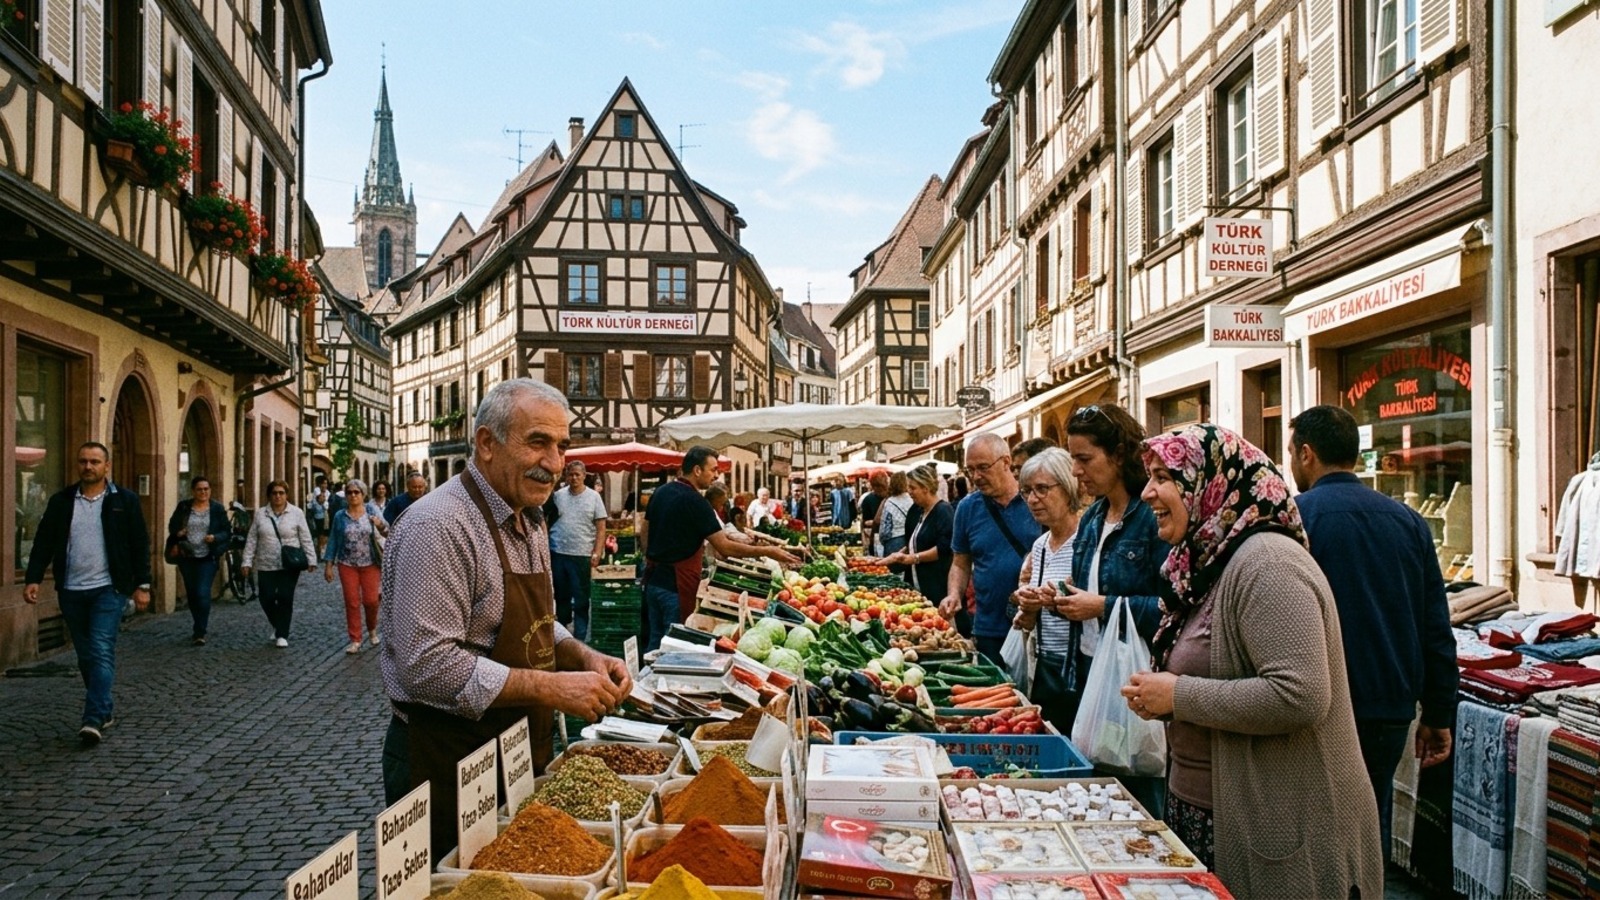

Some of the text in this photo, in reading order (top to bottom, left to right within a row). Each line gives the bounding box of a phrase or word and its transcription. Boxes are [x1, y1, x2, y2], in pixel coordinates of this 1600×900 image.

[1215, 222, 1263, 239] TÜRK
[1212, 241, 1266, 256] KÜLTÜR
[1339, 268, 1425, 320] BAKKALİYESİ
[1233, 308, 1263, 324] TÜRK
[382, 798, 429, 846] Baharatlar
